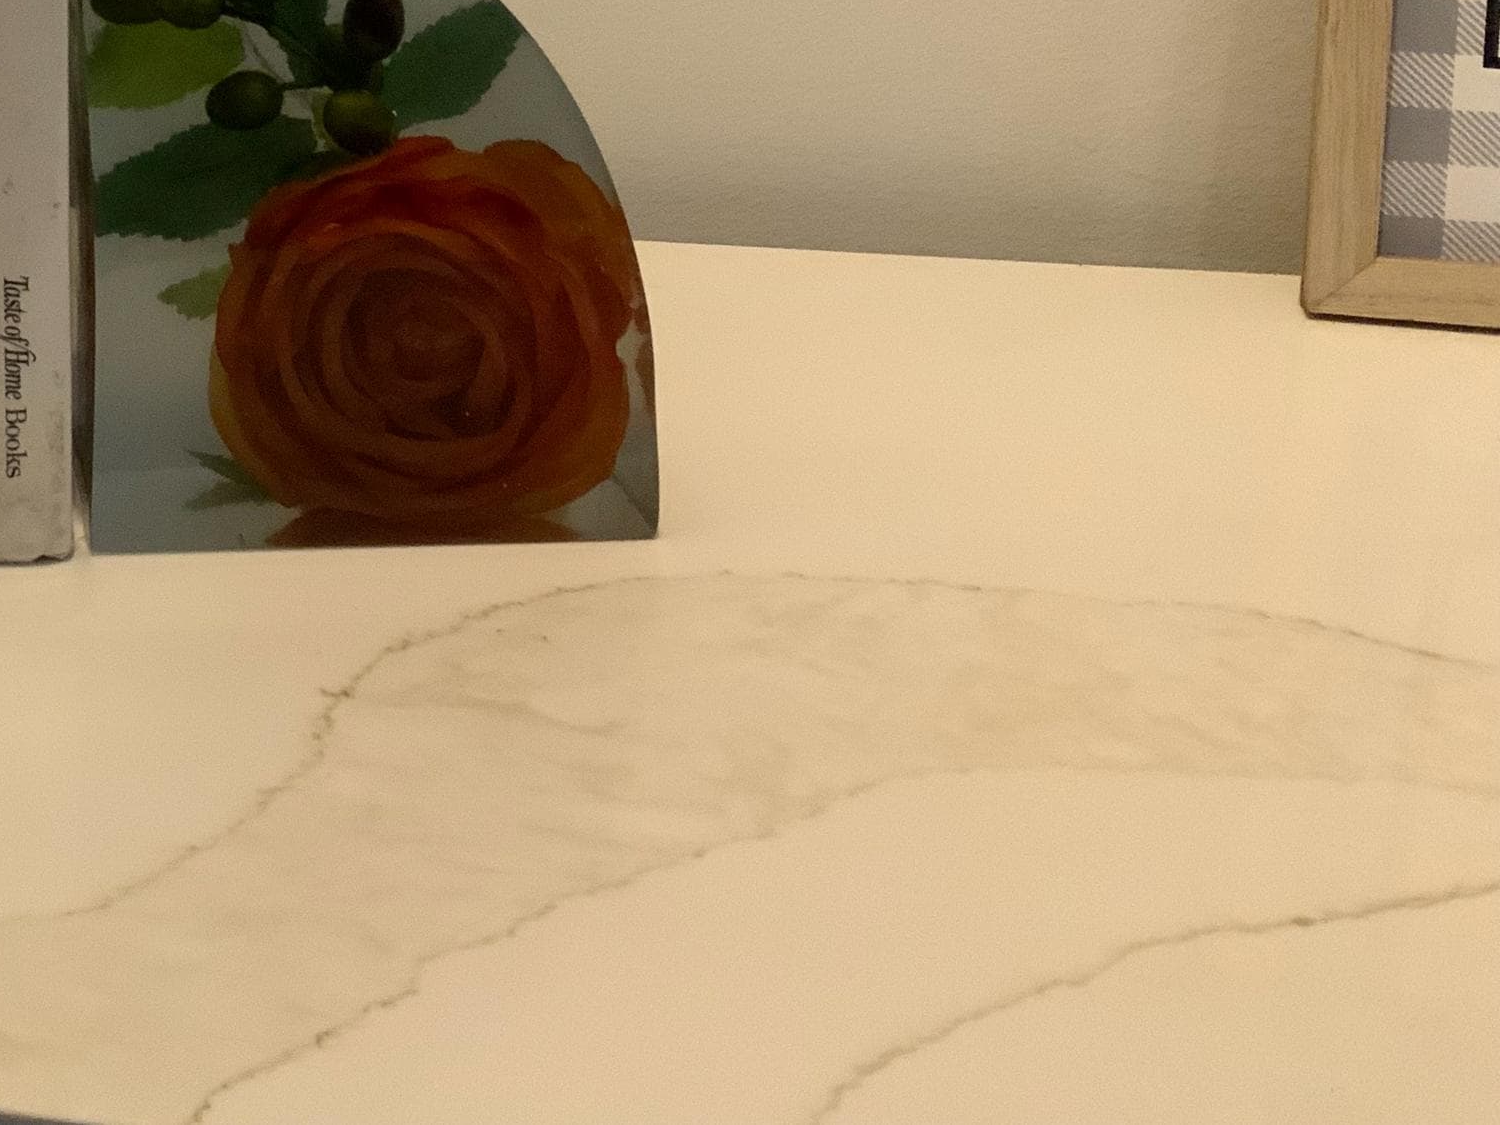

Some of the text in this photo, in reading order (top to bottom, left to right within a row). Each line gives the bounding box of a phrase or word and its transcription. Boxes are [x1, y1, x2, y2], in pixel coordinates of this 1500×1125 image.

[3, 275, 30, 324] Taste
[3, 345, 37, 401] Home
[4, 407, 28, 479] Books
